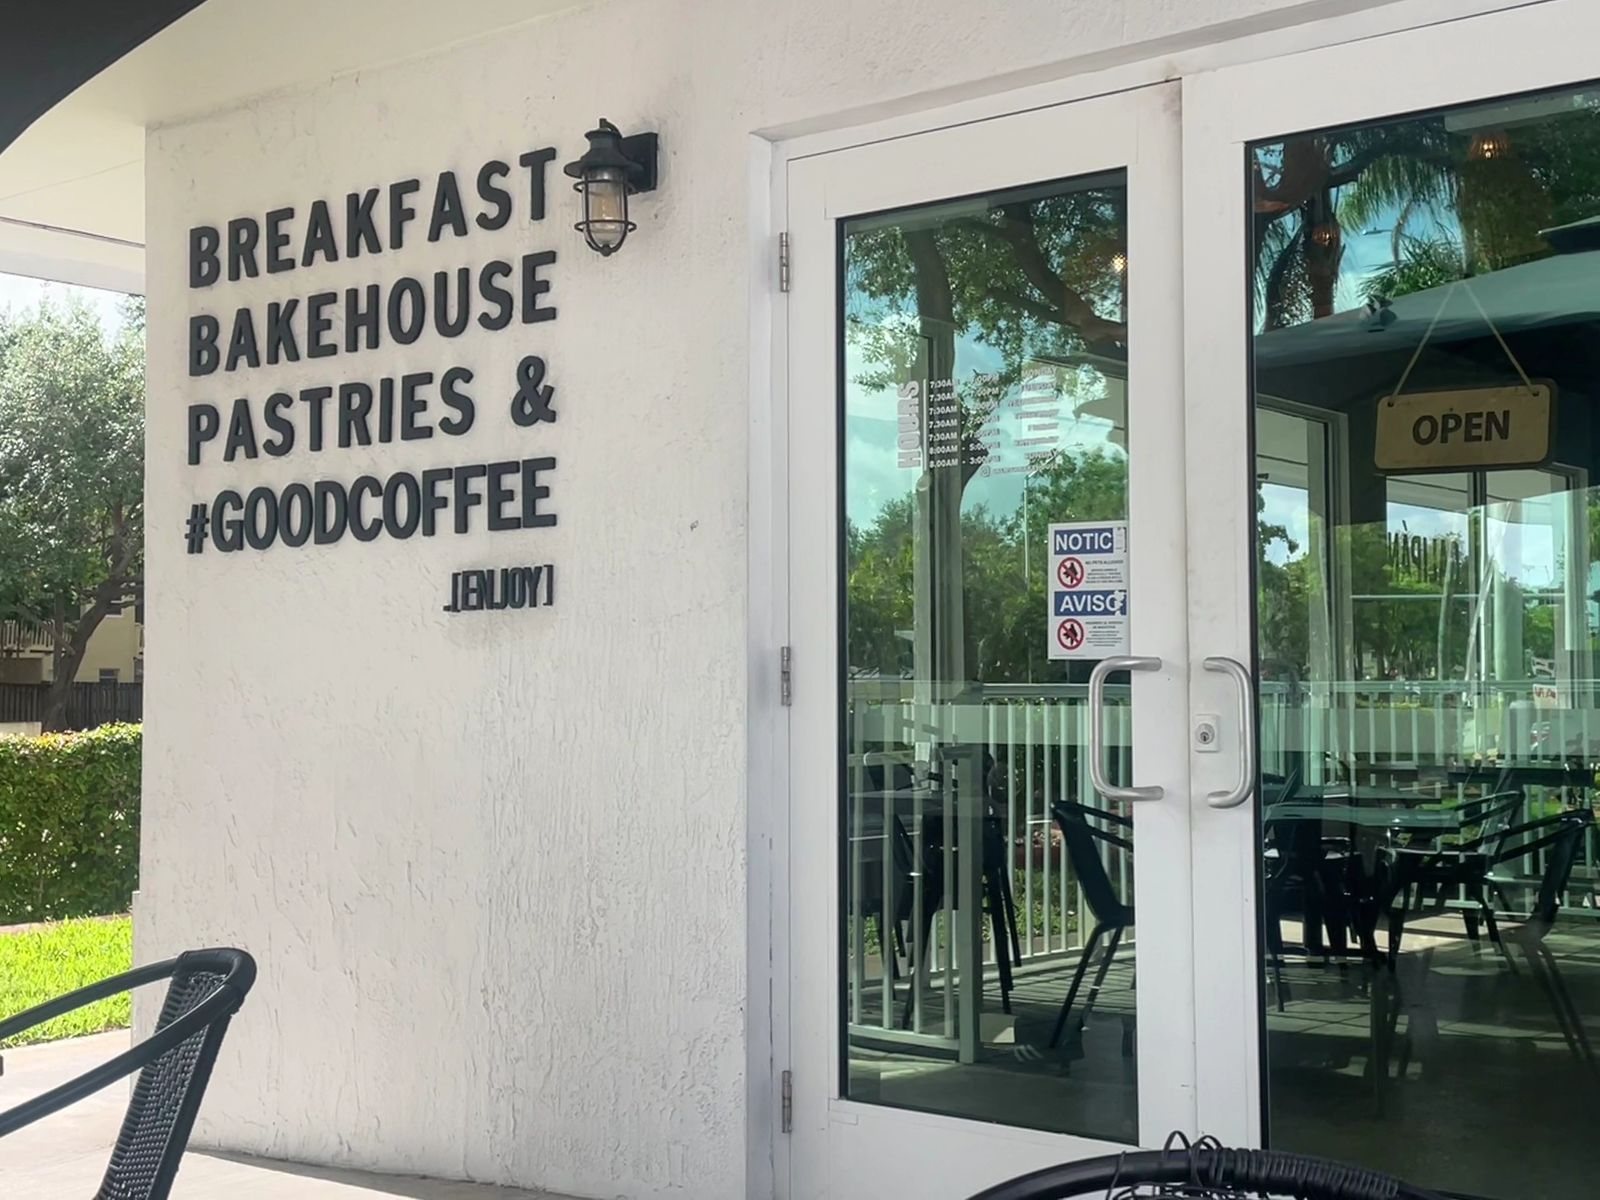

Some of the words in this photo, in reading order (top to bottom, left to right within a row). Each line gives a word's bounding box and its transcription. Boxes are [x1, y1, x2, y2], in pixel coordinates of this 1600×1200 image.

[189, 146, 557, 289] BREAKFAST
[188, 249, 557, 377] BAKEHOUSE
[187, 366, 475, 466] PASTRIES
[510, 355, 557, 428] &
[897, 380, 921, 469] HOURS
[1412, 410, 1510, 446] OPEN
[185, 457, 557, 554] #GOODCOFFEE
[1055, 531, 1114, 551] NOTIC
